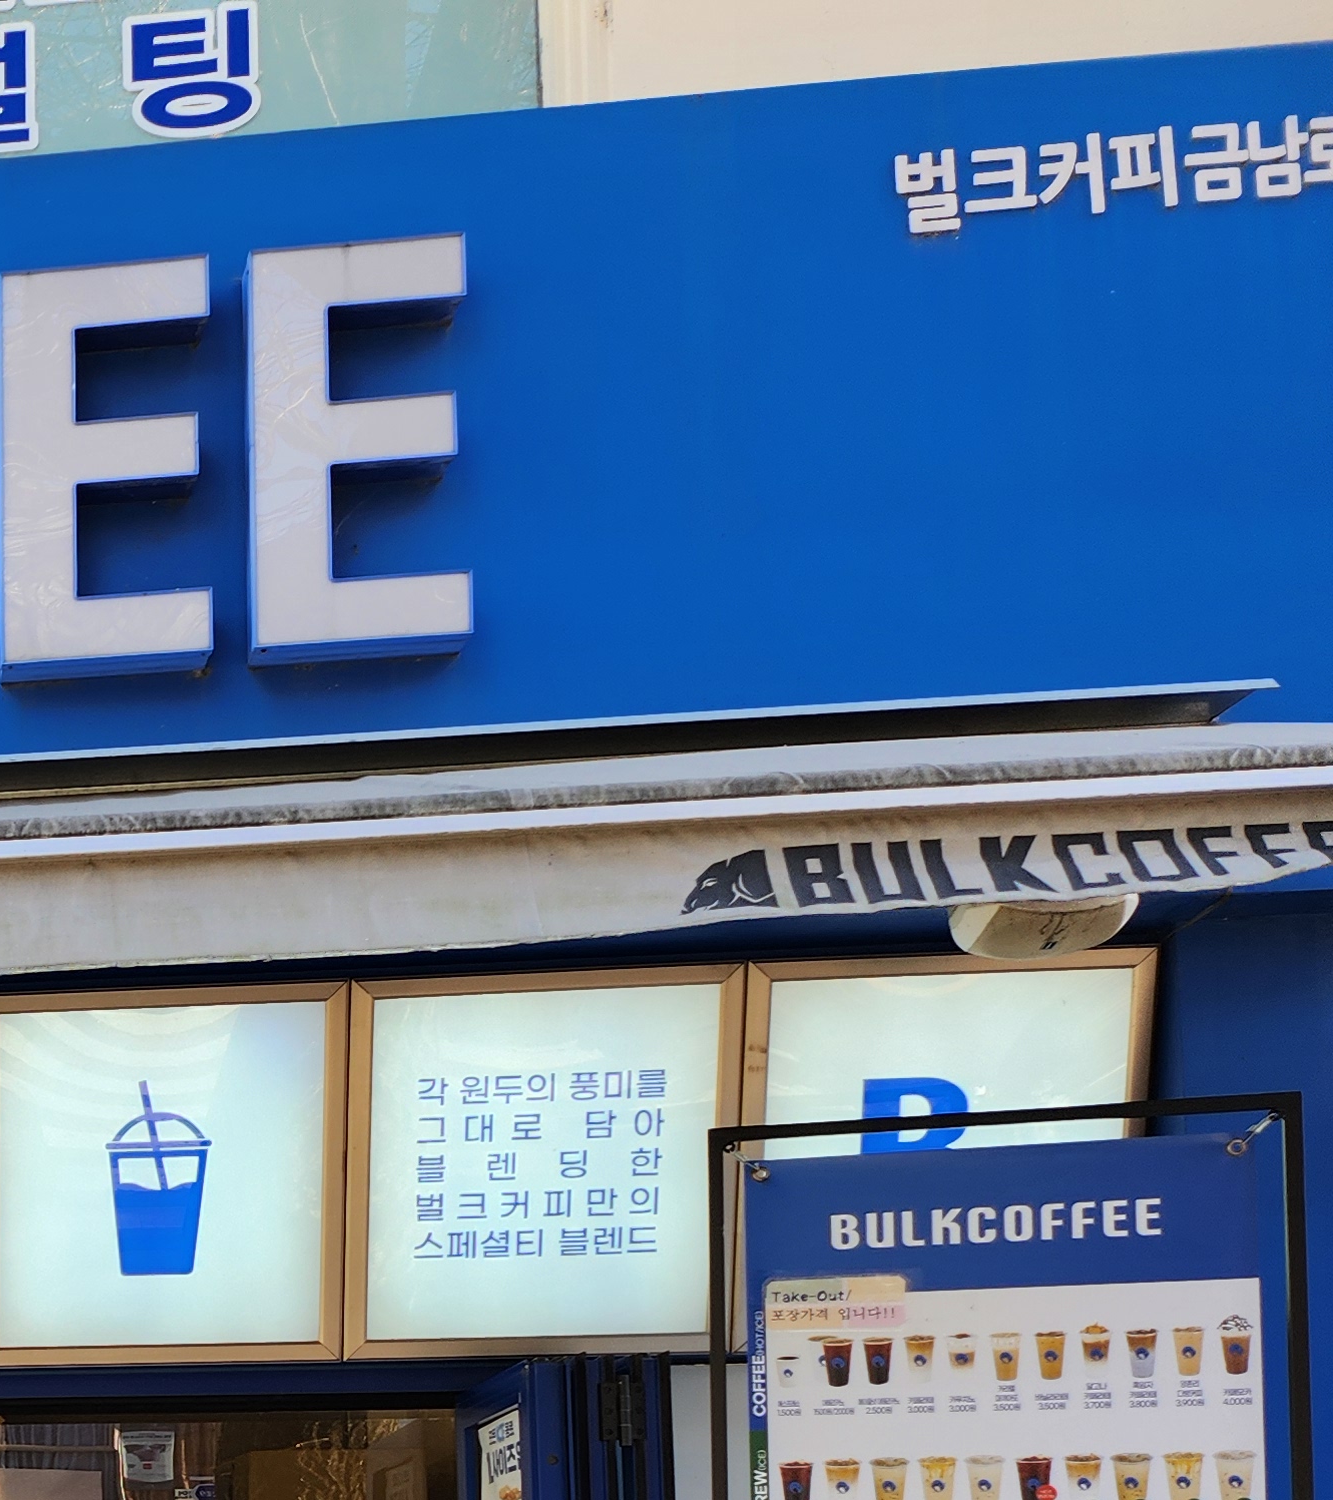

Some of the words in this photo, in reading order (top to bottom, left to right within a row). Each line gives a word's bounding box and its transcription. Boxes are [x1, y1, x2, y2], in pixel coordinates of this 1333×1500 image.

[417, 1076, 449, 1108] 각
[459, 1075, 556, 1105] 원두의
[569, 1068, 668, 1100] 풍미를
[413, 1227, 545, 1261] 스페셜티
[559, 1223, 659, 1257] 블렌드
[830, 1197, 1163, 1251] BULKCOFFEE
